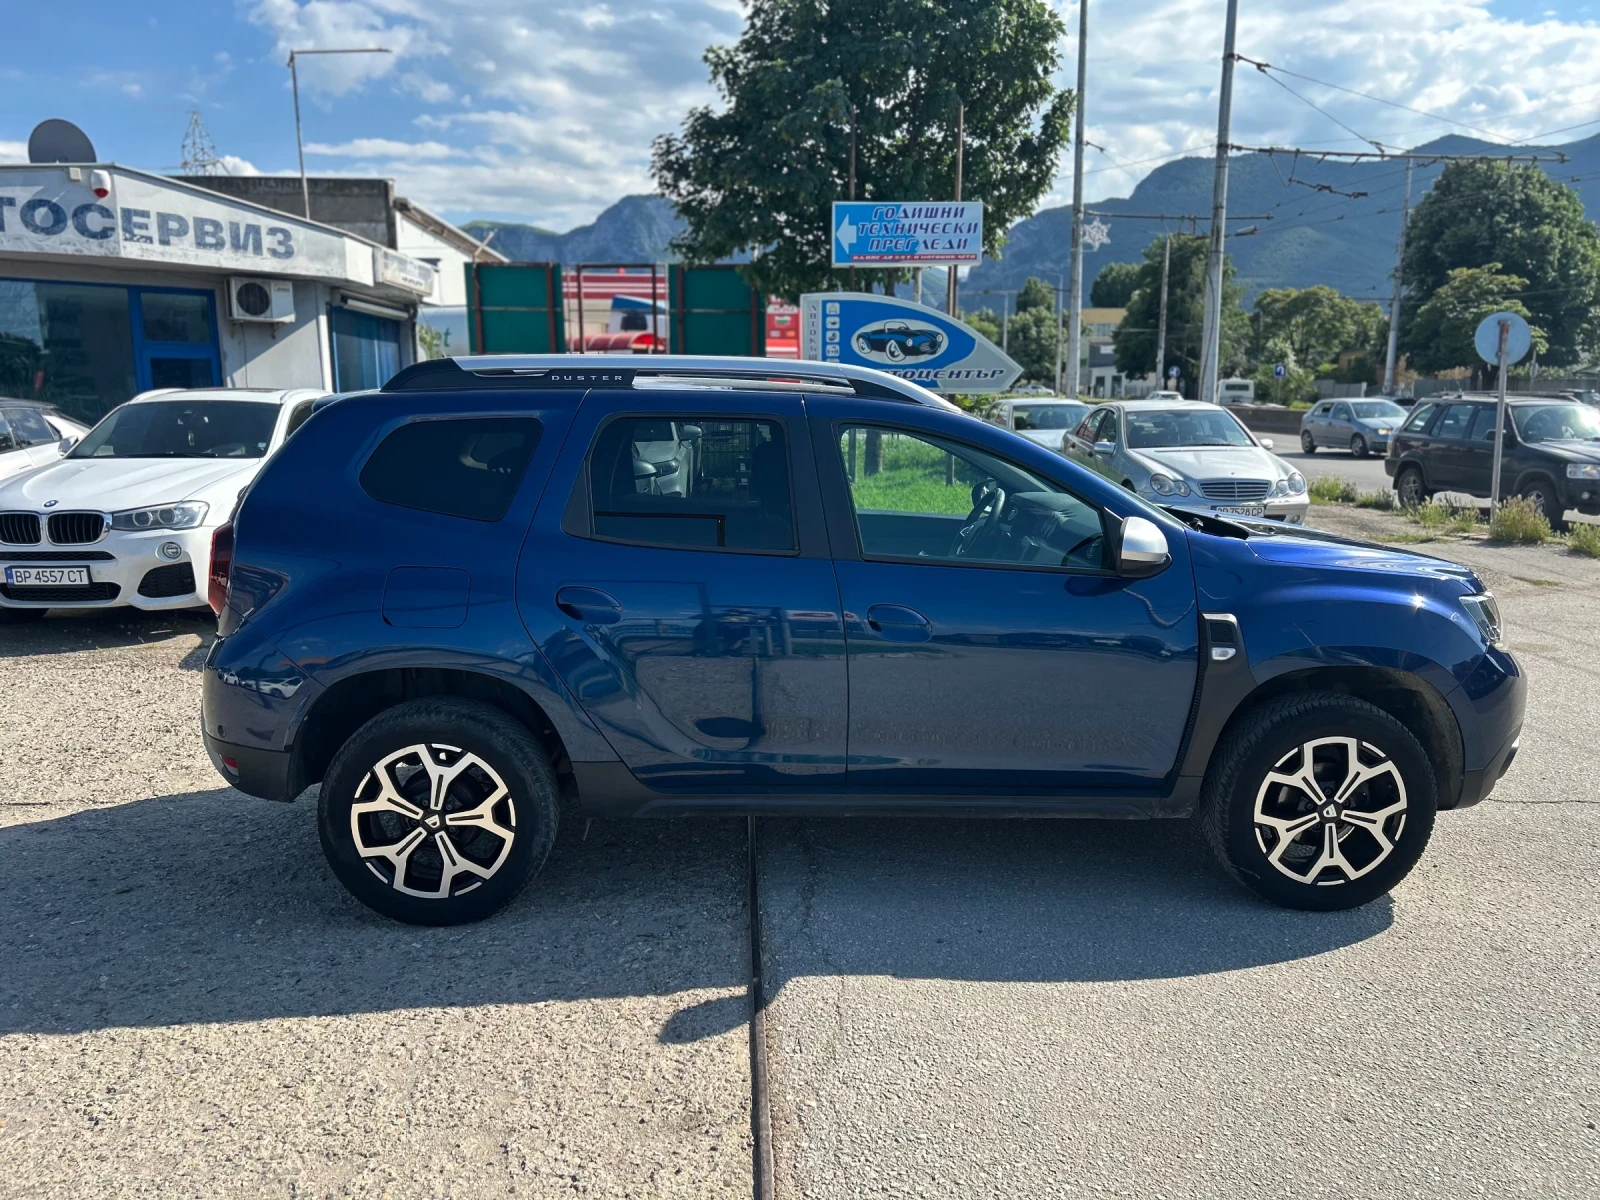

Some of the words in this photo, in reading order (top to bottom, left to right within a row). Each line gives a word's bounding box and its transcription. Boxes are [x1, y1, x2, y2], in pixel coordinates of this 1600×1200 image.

[872, 206, 965, 219] ГОДИШНИ
[858, 222, 979, 235] ТЕХНИЧЕСКИ
[869, 238, 968, 251] ПРЕГЛЕДИ
[882, 369, 1004, 381] ТОЦЕНТЪР
[1230, 507, 1251, 516] 7528
[1252, 507, 1263, 517] CP
[15, 570, 32, 584] BP
[34, 570, 65, 584] 4557
[67, 569, 85, 583] CT
